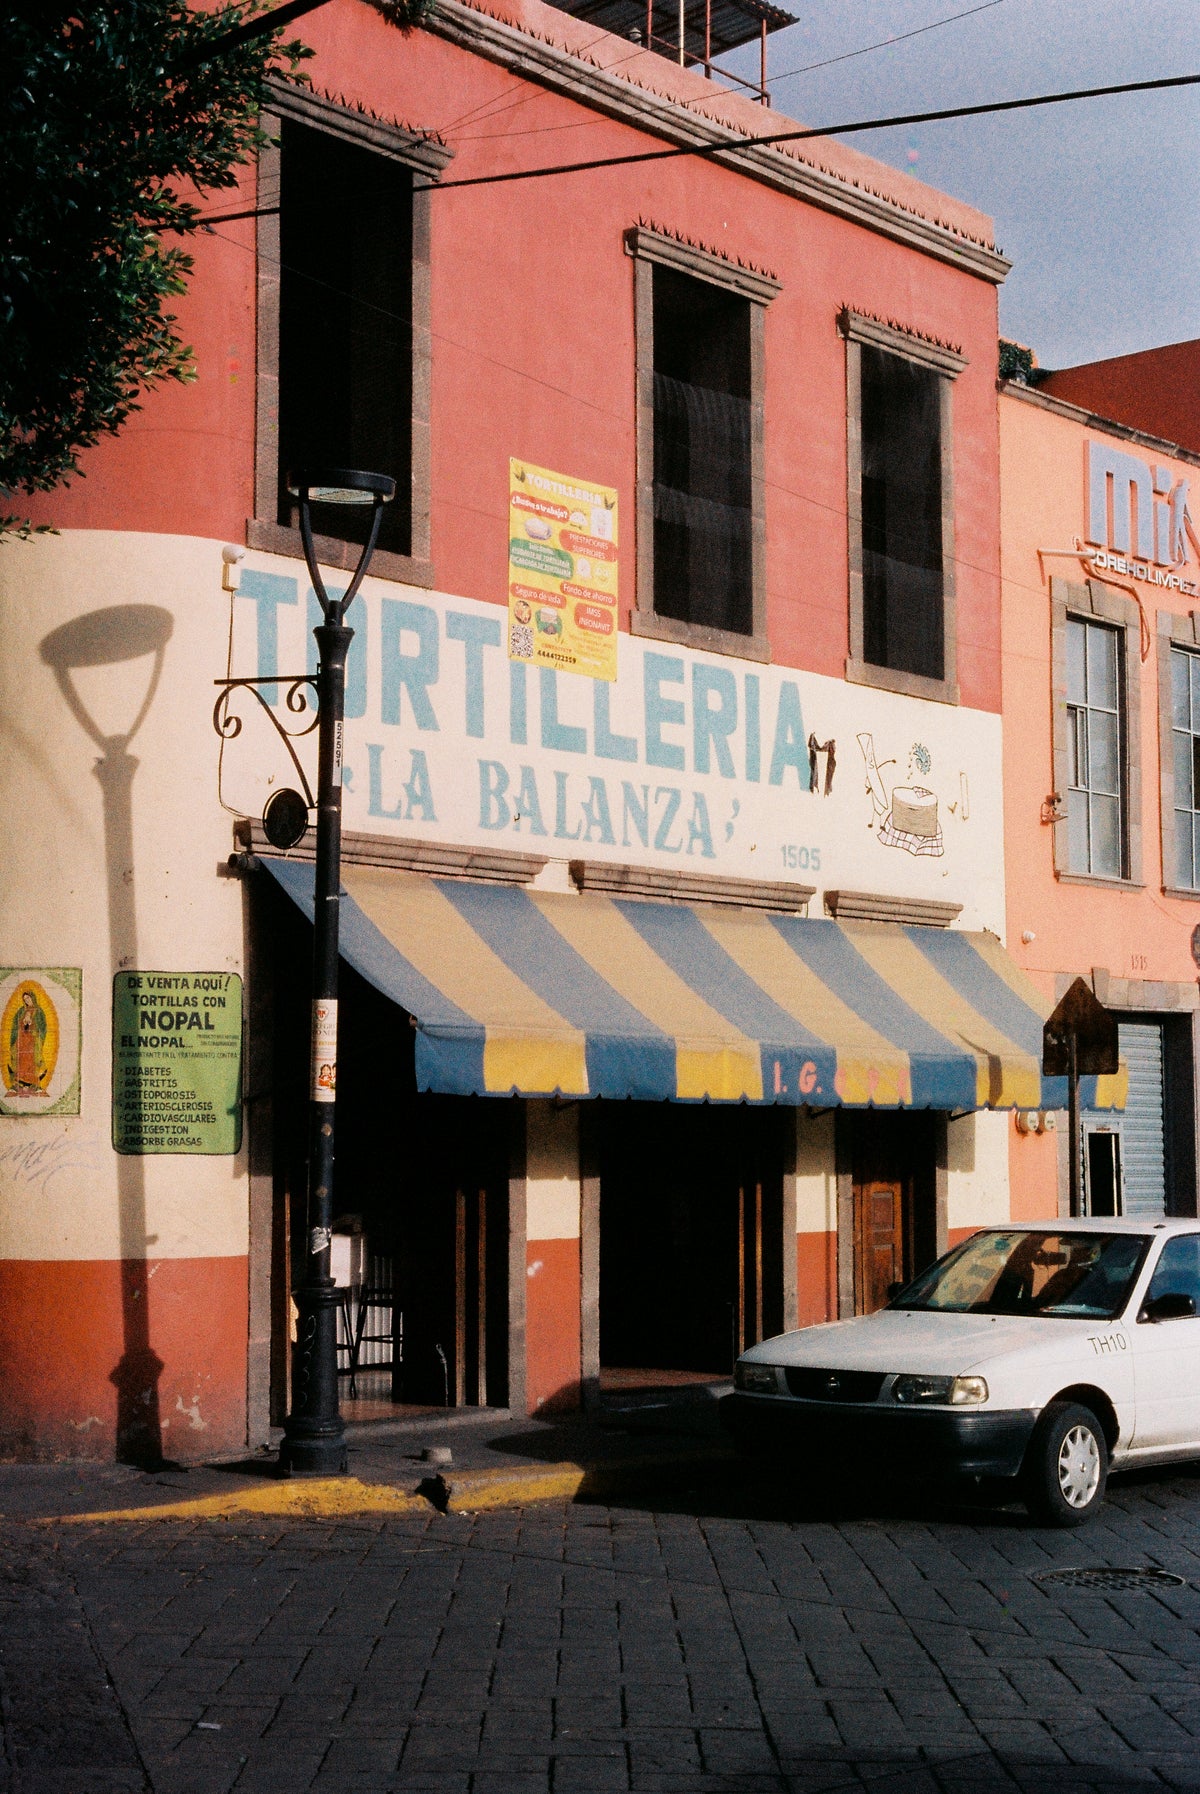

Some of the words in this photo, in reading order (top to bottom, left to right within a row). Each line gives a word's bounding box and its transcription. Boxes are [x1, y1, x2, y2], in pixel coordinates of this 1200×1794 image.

[515, 586, 538, 599] Seguro
[538, 592, 547, 600] de
[548, 594, 561, 604] vida
[563, 584, 582, 596] Fondo
[583, 588, 591, 598] de
[592, 592, 613, 604] ahorro
[586, 607, 601, 618] IMSS
[235, 568, 811, 793] TORTILLERIA
[781, 844, 821, 871] 1505
[128, 977, 143, 989] DE
[147, 977, 190, 989] VENTA
[131, 994, 199, 1008] TORTILLAS
[203, 996, 226, 1008] CON
[140, 1010, 215, 1031] NOPAL
[121, 1035, 135, 1048] EL
[125, 1067, 171, 1076] DIABETES
[124, 1079, 178, 1088] GASTRITIS
[124, 1090, 196, 1099] OSTEOPOROSIS
[124, 1102, 213, 1111] ARTERIOSCLEROSIS
[124, 1114, 217, 1123] CARDIOVASCULARES
[124, 1125, 189, 1134] INDIGESTION
[123, 1137, 165, 1146] ABSORBE
[166, 1137, 202, 1146] GRASAS
[1087, 1333, 1127, 1355] TH10
